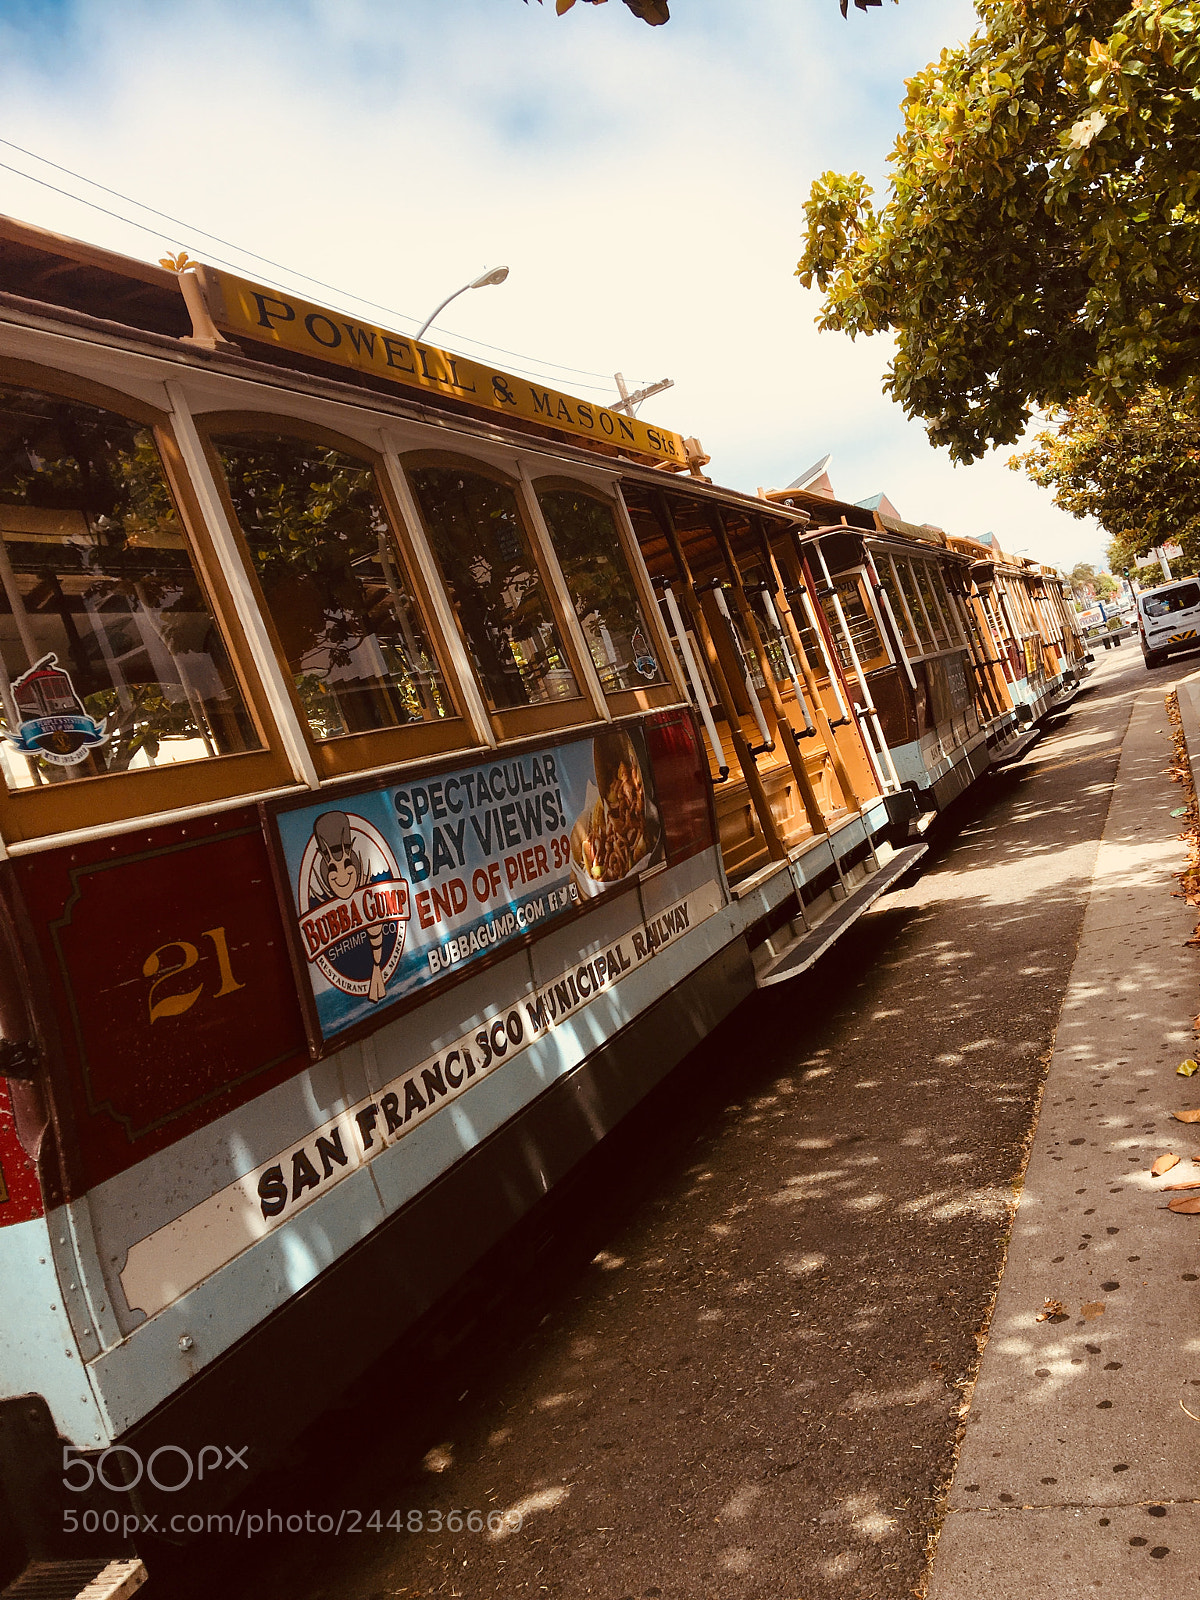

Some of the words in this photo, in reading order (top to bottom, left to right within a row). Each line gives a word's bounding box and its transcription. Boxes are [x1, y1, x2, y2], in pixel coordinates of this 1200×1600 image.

[250, 290, 476, 393] POWELL
[493, 375, 517, 406] &
[529, 387, 636, 442] MASON
[395, 755, 559, 829] SPECTACULAR
[403, 825, 466, 885] BAY
[471, 788, 567, 858] VIEWS!
[301, 899, 363, 955] BUBBA
[363, 889, 406, 921] GUMP
[415, 878, 468, 931] END
[473, 869, 501, 903] OF
[507, 851, 548, 890] PIER
[553, 836, 571, 869] 39
[142, 926, 246, 1025] 21
[319, 957, 368, 992] RESTAURANT
[328, 931, 367, 961] SHRIMP
[427, 900, 545, 975] BUBBAGUMP.COM
[257, 1128, 349, 1221] SAN
[356, 1014, 525, 1151] FRANCISCO
[526, 944, 631, 1033] MUNICIPAL
[631, 901, 690, 960] RAILWAY
